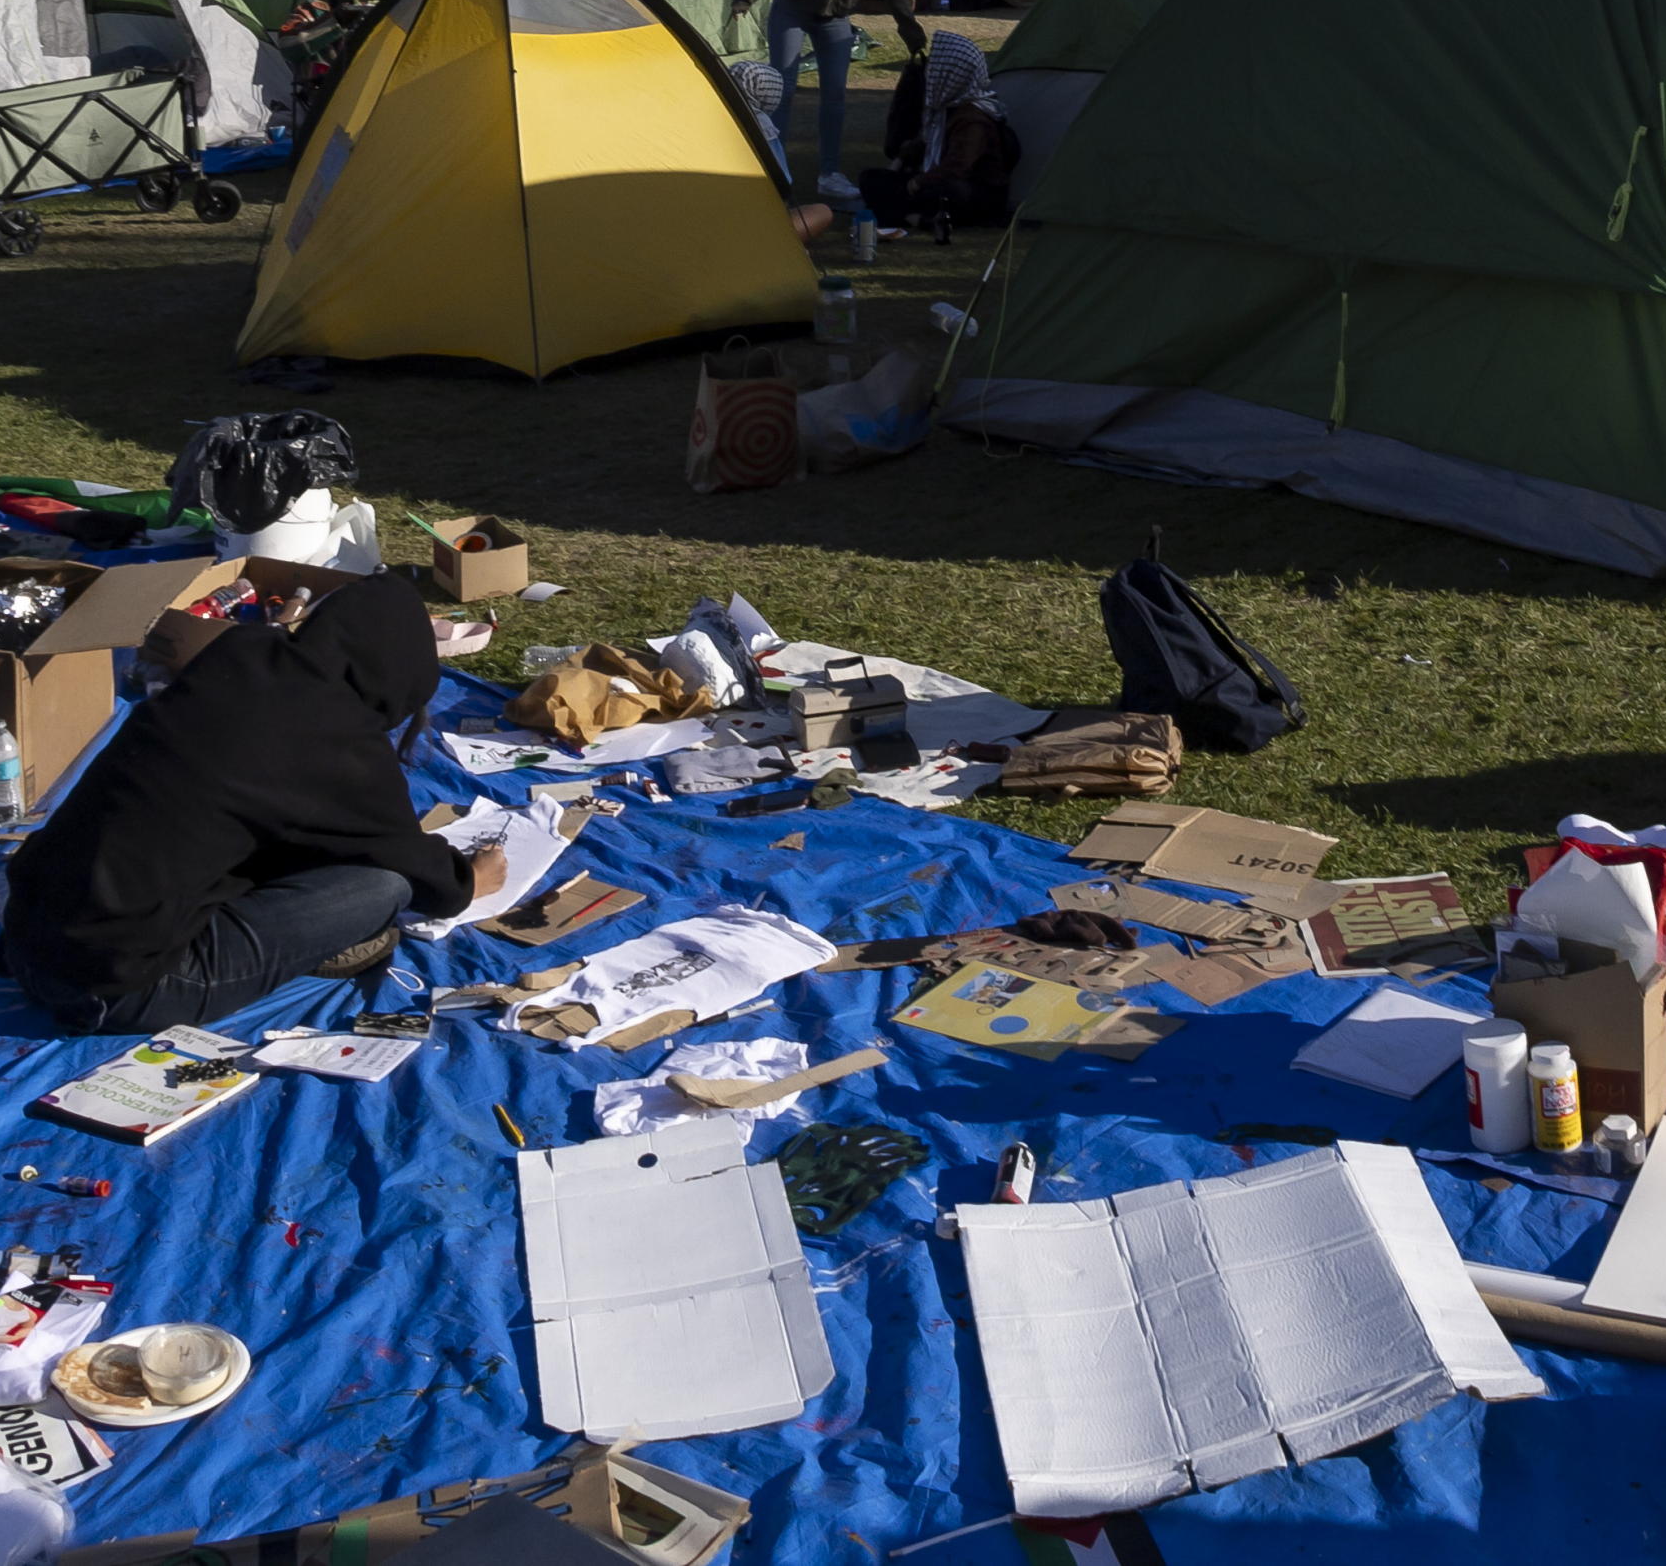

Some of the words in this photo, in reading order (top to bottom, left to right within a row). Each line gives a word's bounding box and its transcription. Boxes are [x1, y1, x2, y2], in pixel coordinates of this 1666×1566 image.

[1227, 854, 1316, 875] 3024T
[73, 1081, 175, 1118] WATERCOLOR
[99, 1072, 185, 1107] AQUARELLE
